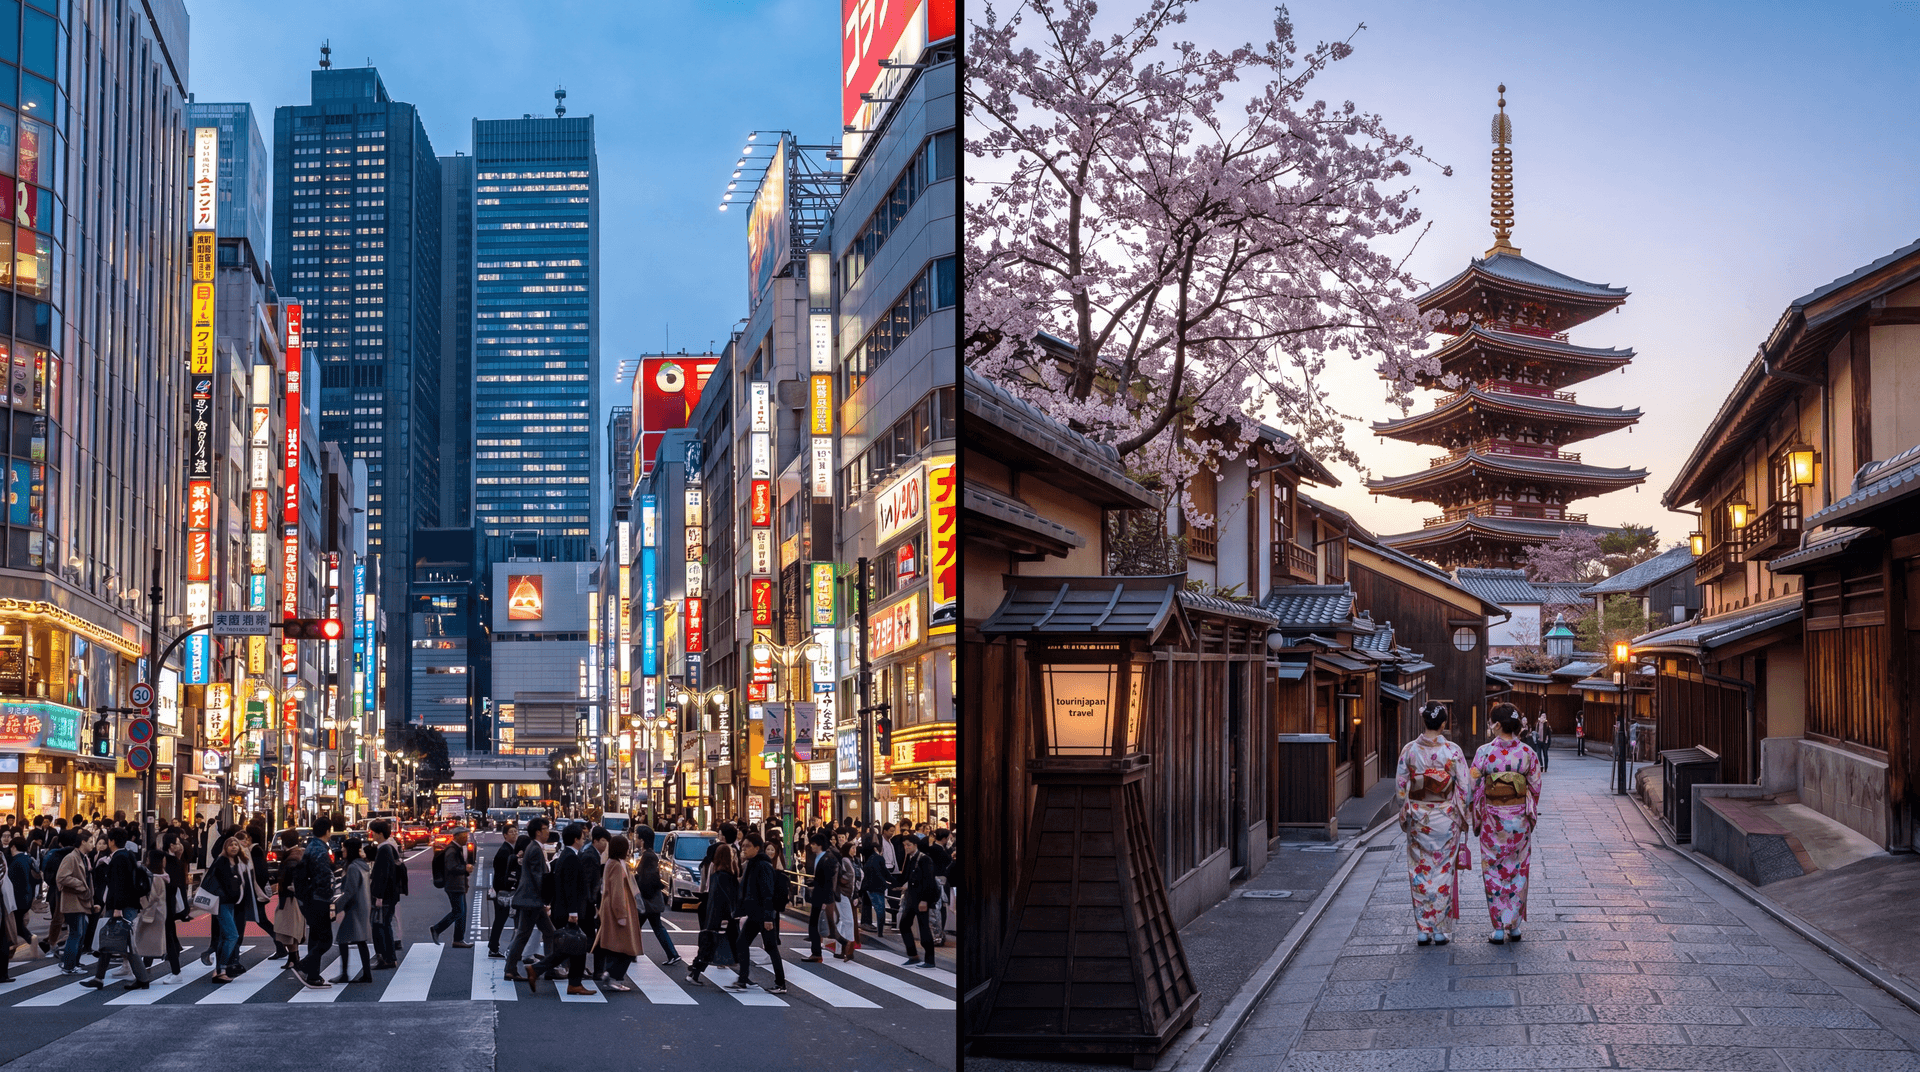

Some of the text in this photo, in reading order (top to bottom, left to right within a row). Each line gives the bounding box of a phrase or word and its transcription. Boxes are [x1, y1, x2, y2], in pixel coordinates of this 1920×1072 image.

[134, 690, 149, 701] 30
[1056, 697, 1106, 707] tourinjapan
[1068, 708, 1094, 717] travel
